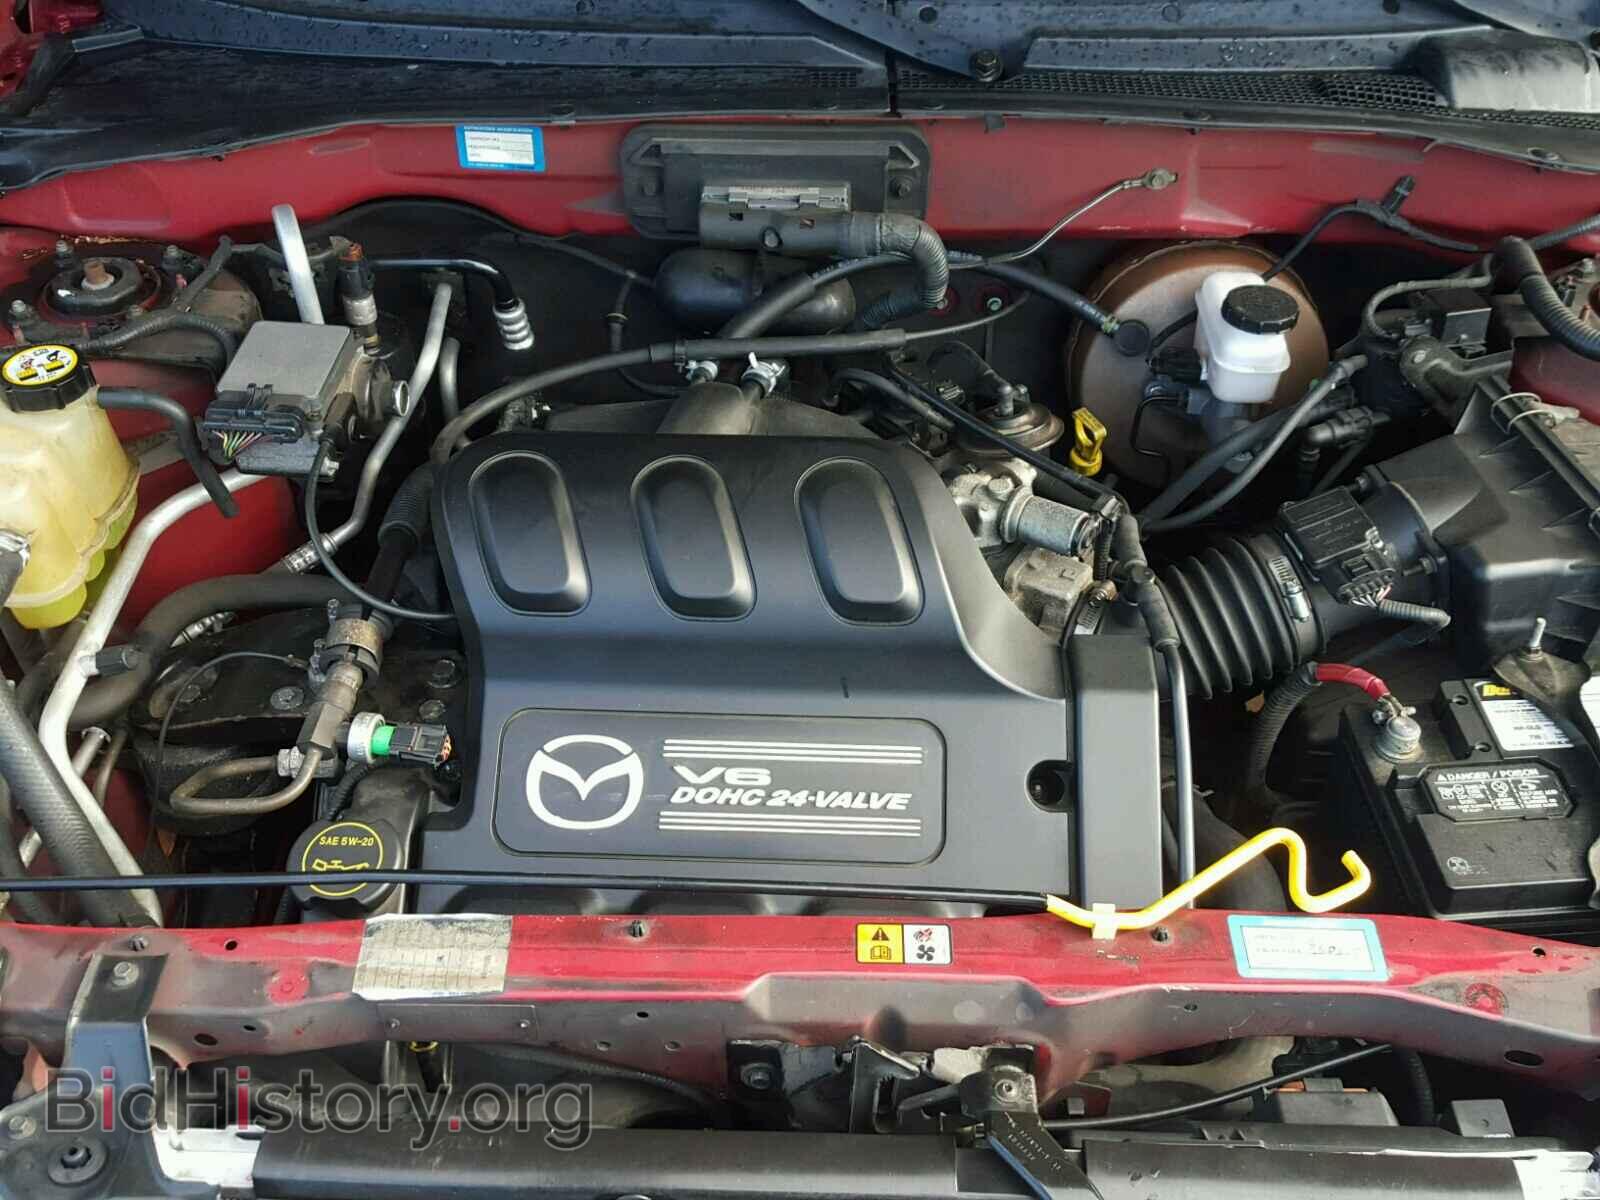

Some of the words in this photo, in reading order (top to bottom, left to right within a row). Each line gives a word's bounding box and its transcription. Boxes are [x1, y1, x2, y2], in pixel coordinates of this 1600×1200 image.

[673, 765, 772, 786] V6
[670, 786, 766, 806] DOHC
[766, 789, 913, 810] 24-VALVE
[319, 836, 339, 847] SAE
[340, 836, 375, 847] 5W-20
